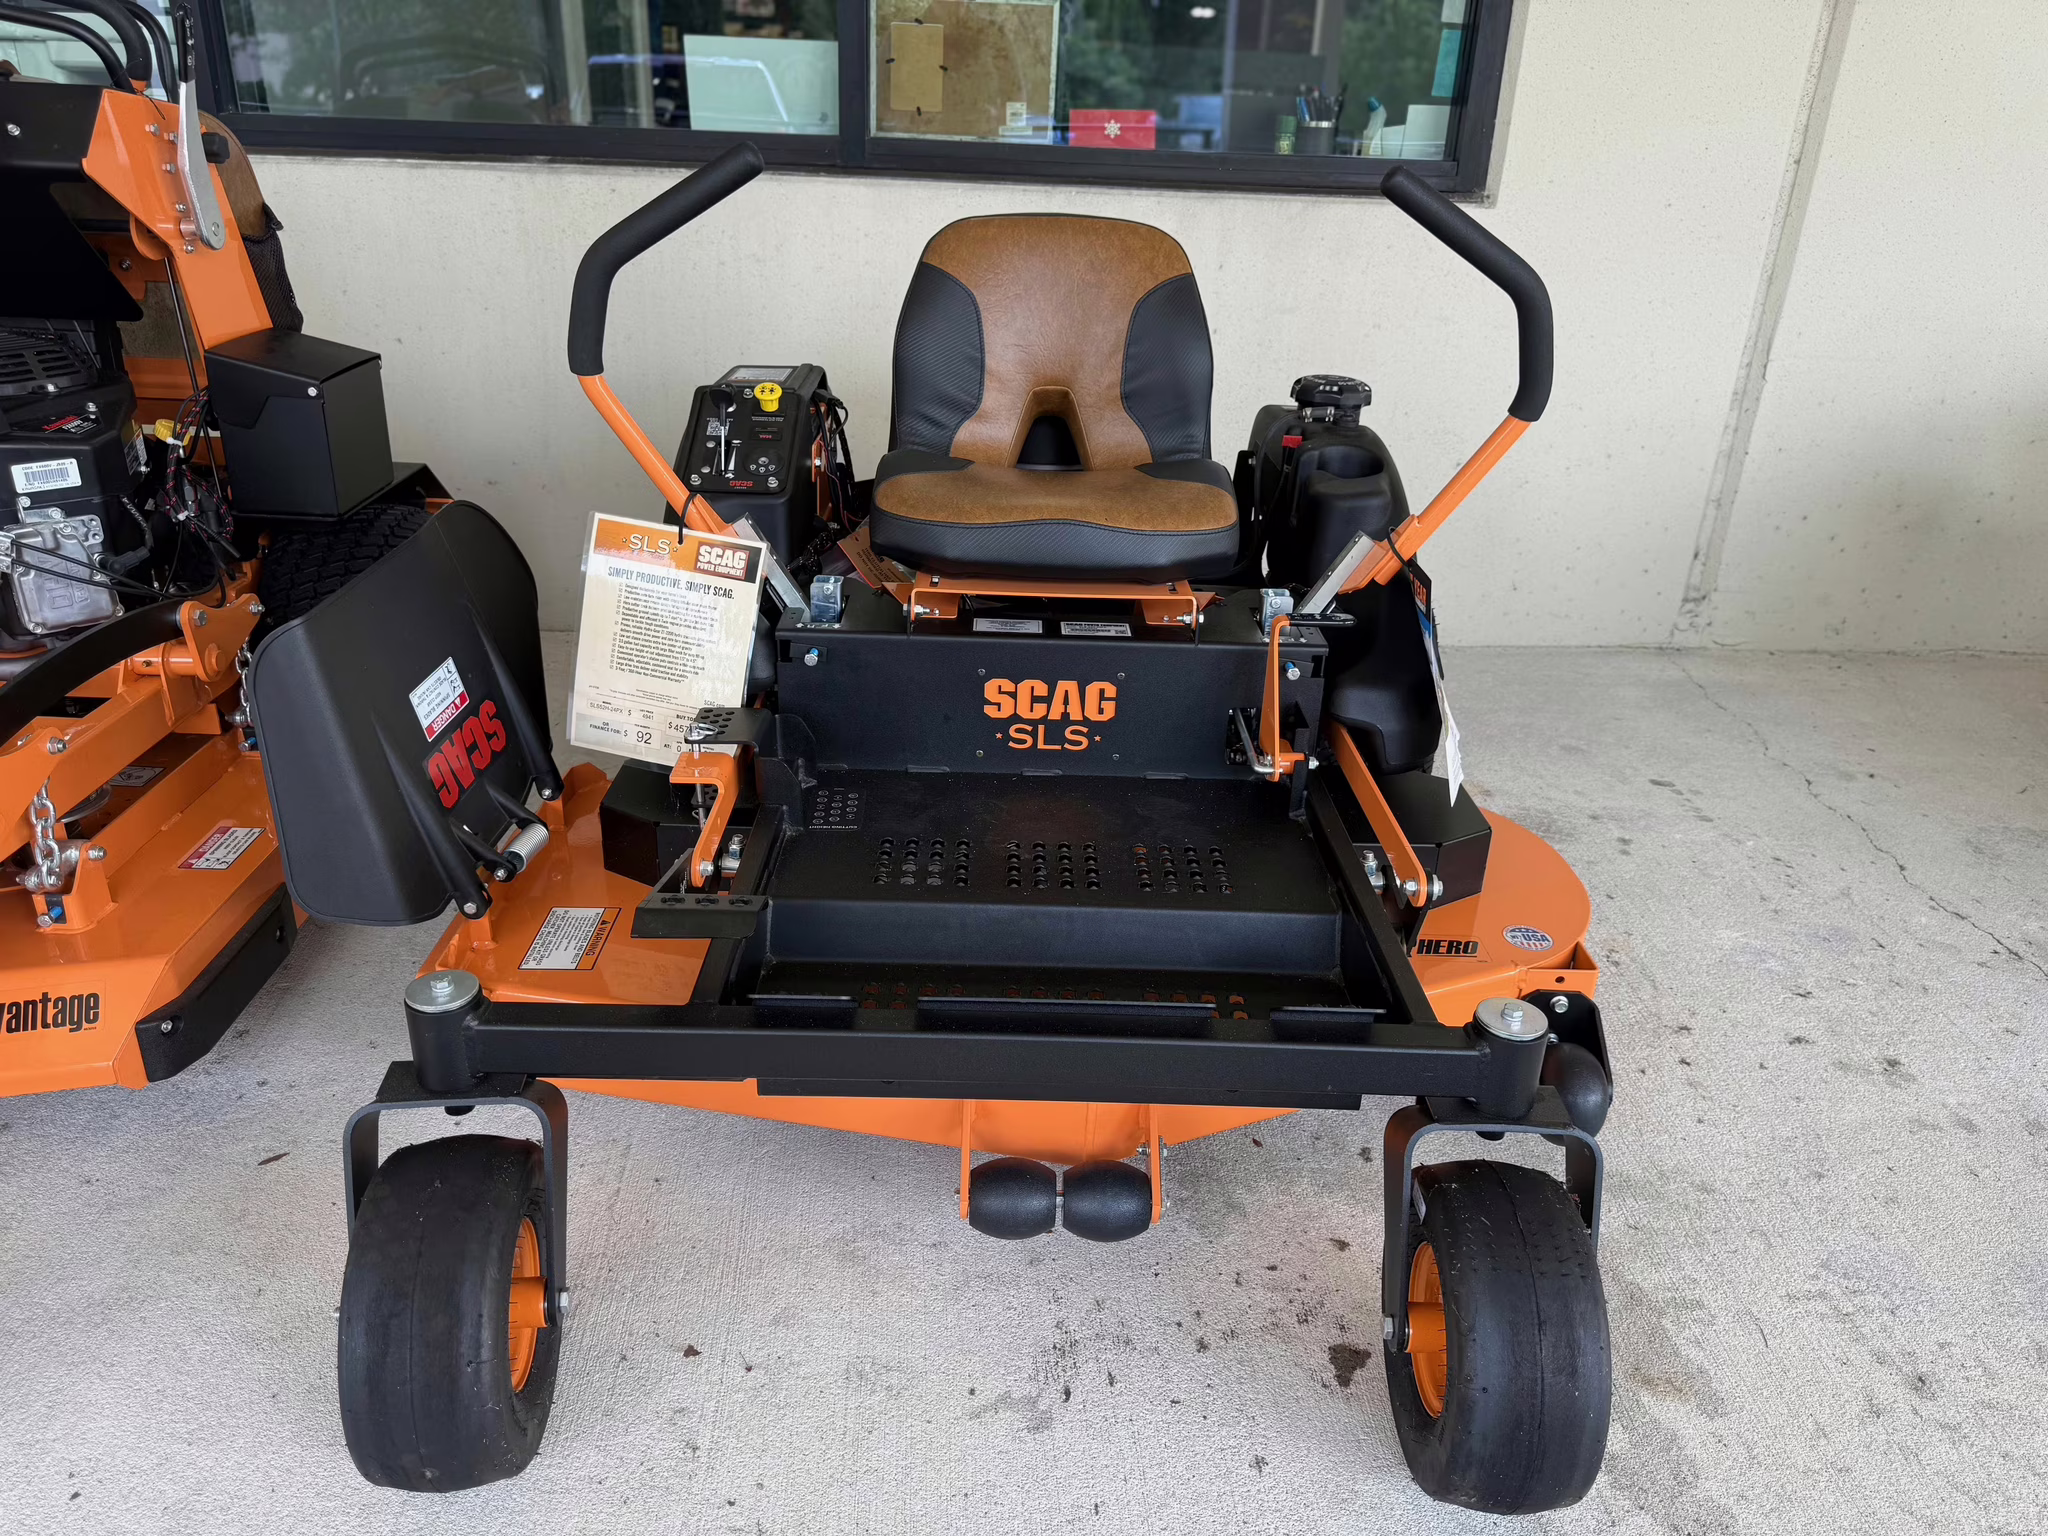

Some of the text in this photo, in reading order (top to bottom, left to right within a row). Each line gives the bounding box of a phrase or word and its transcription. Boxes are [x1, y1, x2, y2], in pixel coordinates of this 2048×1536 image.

[628, 533, 671, 555] SLS
[696, 561, 744, 577] POWER EQUIPMENT
[698, 544, 746, 570] SCAG
[607, 566, 634, 580] SIMPLY
[635, 571, 683, 590] PRODUCTIVE.
[685, 580, 712, 595] SIMPLY
[712, 586, 735, 599] SCAG.
[423, 693, 450, 720] SPINNING BLADES
[984, 678, 1118, 722] SCAG
[432, 704, 455, 730] DANGER
[589, 723, 609, 732] FINANCE
[667, 721, 673, 729] $
[623, 729, 652, 744] $ 92
[1008, 723, 1090, 751] SLS
[426, 699, 506, 808] SCAG
[581, 930, 591, 943] BLADES
[585, 927, 604, 956] WARNING
[1416, 939, 1479, 955] HERO
[1522, 933, 1550, 943] USA
